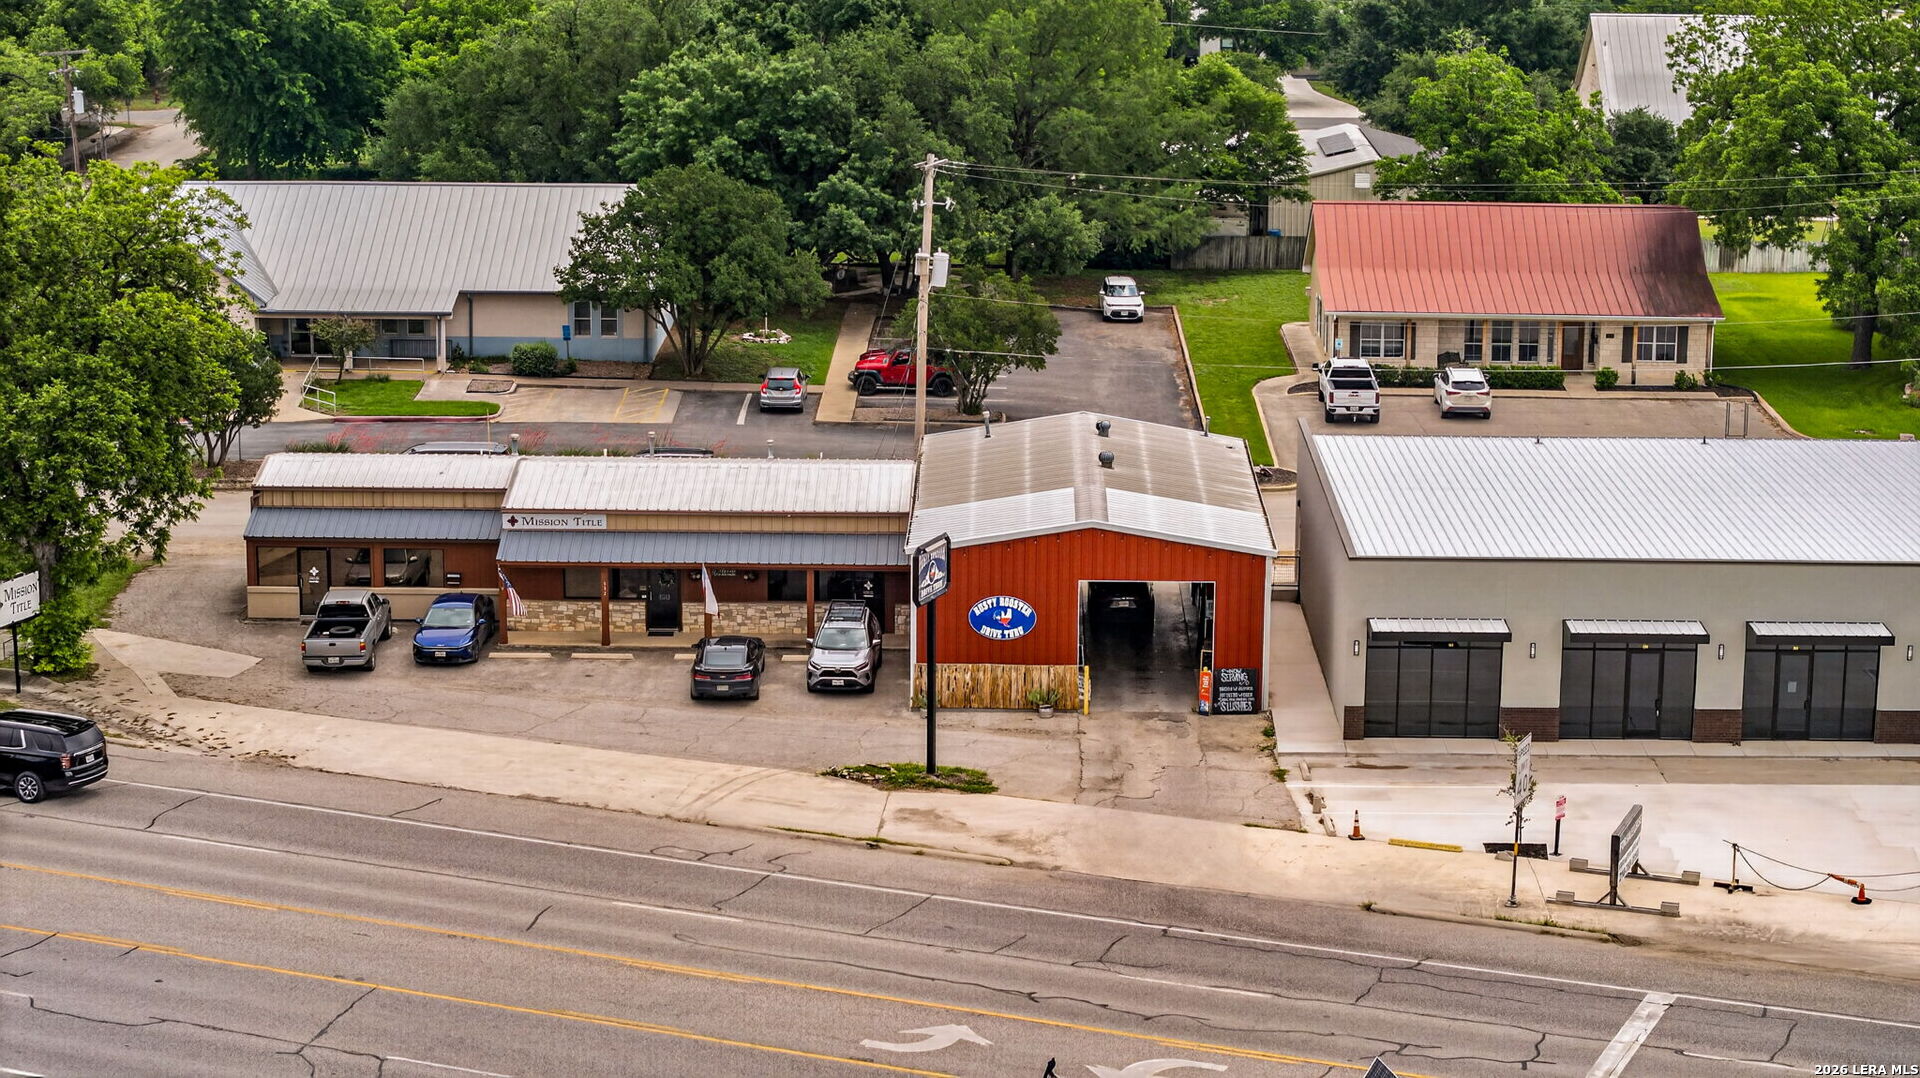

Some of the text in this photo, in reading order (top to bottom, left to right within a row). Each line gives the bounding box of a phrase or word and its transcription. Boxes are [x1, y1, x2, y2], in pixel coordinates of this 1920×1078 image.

[521, 516, 603, 527] MISSION TITLE
[4, 582, 38, 602] MISSION
[10, 600, 32, 615] TITLE
[972, 597, 1033, 618] RUSTY ROOSTER
[980, 625, 1024, 639] DRIVE THRU
